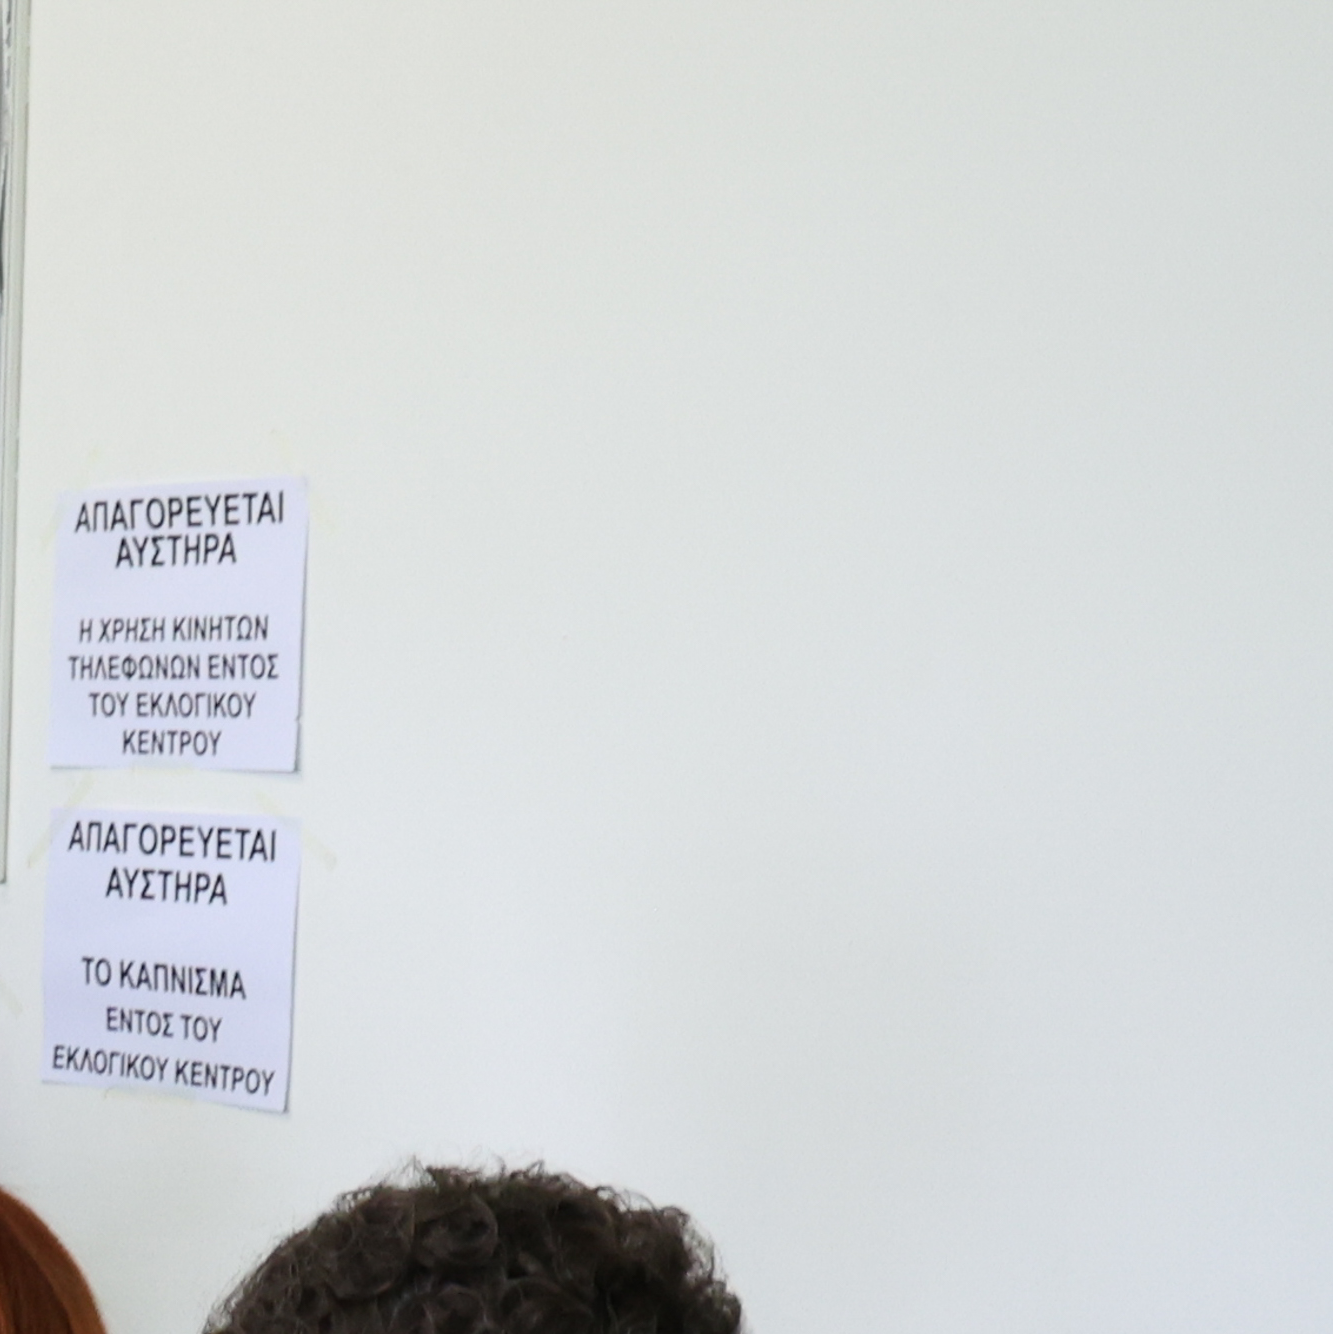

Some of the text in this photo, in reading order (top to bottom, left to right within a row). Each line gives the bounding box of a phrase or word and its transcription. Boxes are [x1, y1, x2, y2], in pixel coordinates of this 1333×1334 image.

[75, 490, 284, 533] ΑΠΑΓΟΡΕΥΕΤΑΙ
[115, 533, 237, 568] ΑΥΣΤΗΡΑ
[79, 615, 269, 643] Η ΧΡΗΣΗ ΚΙΝΗΤΩΝ
[68, 654, 279, 680] ΤΗΛΕΦΩΝΩΝ ΕΝΤΟΣ
[88, 692, 256, 718] ΤΟΥ ΕΚΛΟΓΙΚΟΥ
[122, 730, 222, 756] ΚΕΝΤΡΟΥ
[68, 821, 276, 862] ΑΠΑΓΟΡΕΥΕΤΑΙ
[105, 868, 227, 905] ΑΥΣΤΗΡΑ
[82, 956, 246, 1000] ΤΟ ΚΑΠΝΙΣΜΑ
[106, 1006, 222, 1042] ΕΝΤΟΣ ΤΟΥ
[52, 1044, 275, 1097] ΕΚΛΟΓΙΚΟΥ ΚΕΝΤΡΟΥ
